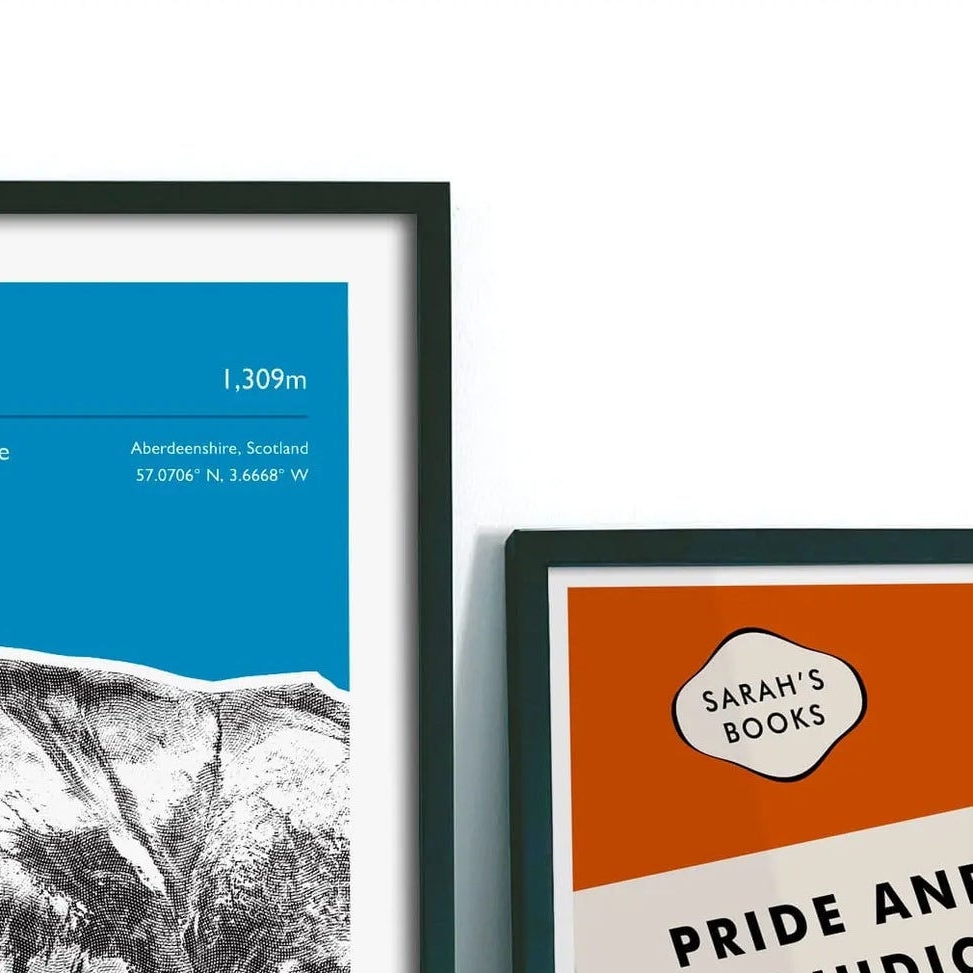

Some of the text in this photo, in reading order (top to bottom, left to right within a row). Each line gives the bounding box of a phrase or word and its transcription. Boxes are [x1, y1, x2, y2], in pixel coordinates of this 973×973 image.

[224, 367, 307, 392] 1,309m
[130, 441, 309, 456] Aberdeenshire, Scotland
[136, 468, 201, 482] 57.0706°
[229, 468, 285, 482] 3.6668°
[290, 468, 309, 482] W
[702, 668, 825, 713] SARAH'S
[723, 703, 825, 744] BOOKS
[668, 893, 846, 968] PRIDE
